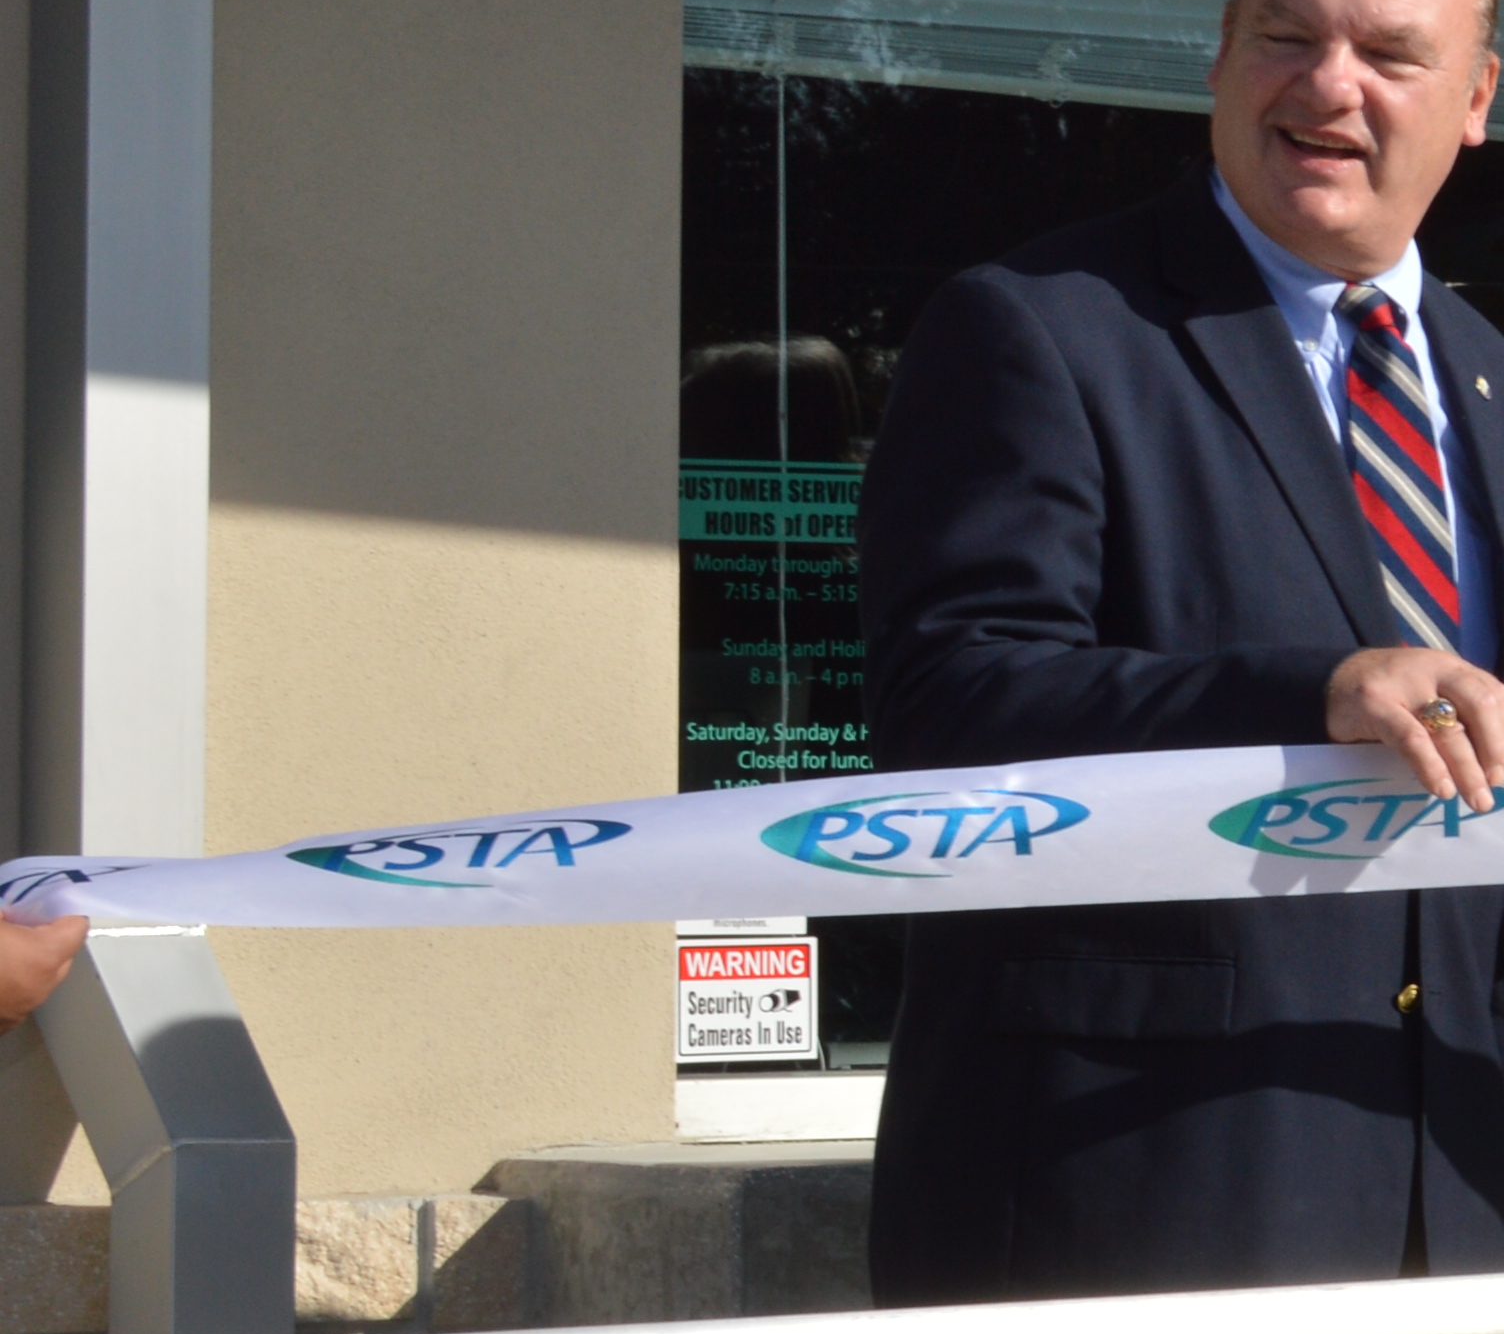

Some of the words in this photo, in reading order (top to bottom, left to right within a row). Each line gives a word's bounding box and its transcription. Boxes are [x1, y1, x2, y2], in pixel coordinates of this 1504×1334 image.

[788, 478, 861, 504] SERVIC
[705, 511, 776, 536] HOURS
[694, 553, 768, 577] Monday
[723, 581, 761, 601] 7:15
[721, 638, 788, 660] Sunday
[792, 639, 828, 658] and
[749, 667, 762, 685] 8
[685, 721, 771, 746] Saturday,
[773, 722, 840, 746] Sunday
[841, 723, 858, 742] &
[737, 749, 798, 770] Closed
[801, 749, 828, 770] for
[830, 750, 874, 770] lunc
[323, 825, 578, 873] PSTA
[794, 805, 1033, 863] PSTA
[1238, 791, 1460, 846] PSTA
[684, 949, 806, 978] WARNING
[687, 991, 754, 1019] Security
[687, 1023, 753, 1048] Cameras
[757, 1021, 772, 1045] In
[776, 1021, 803, 1045] Use
